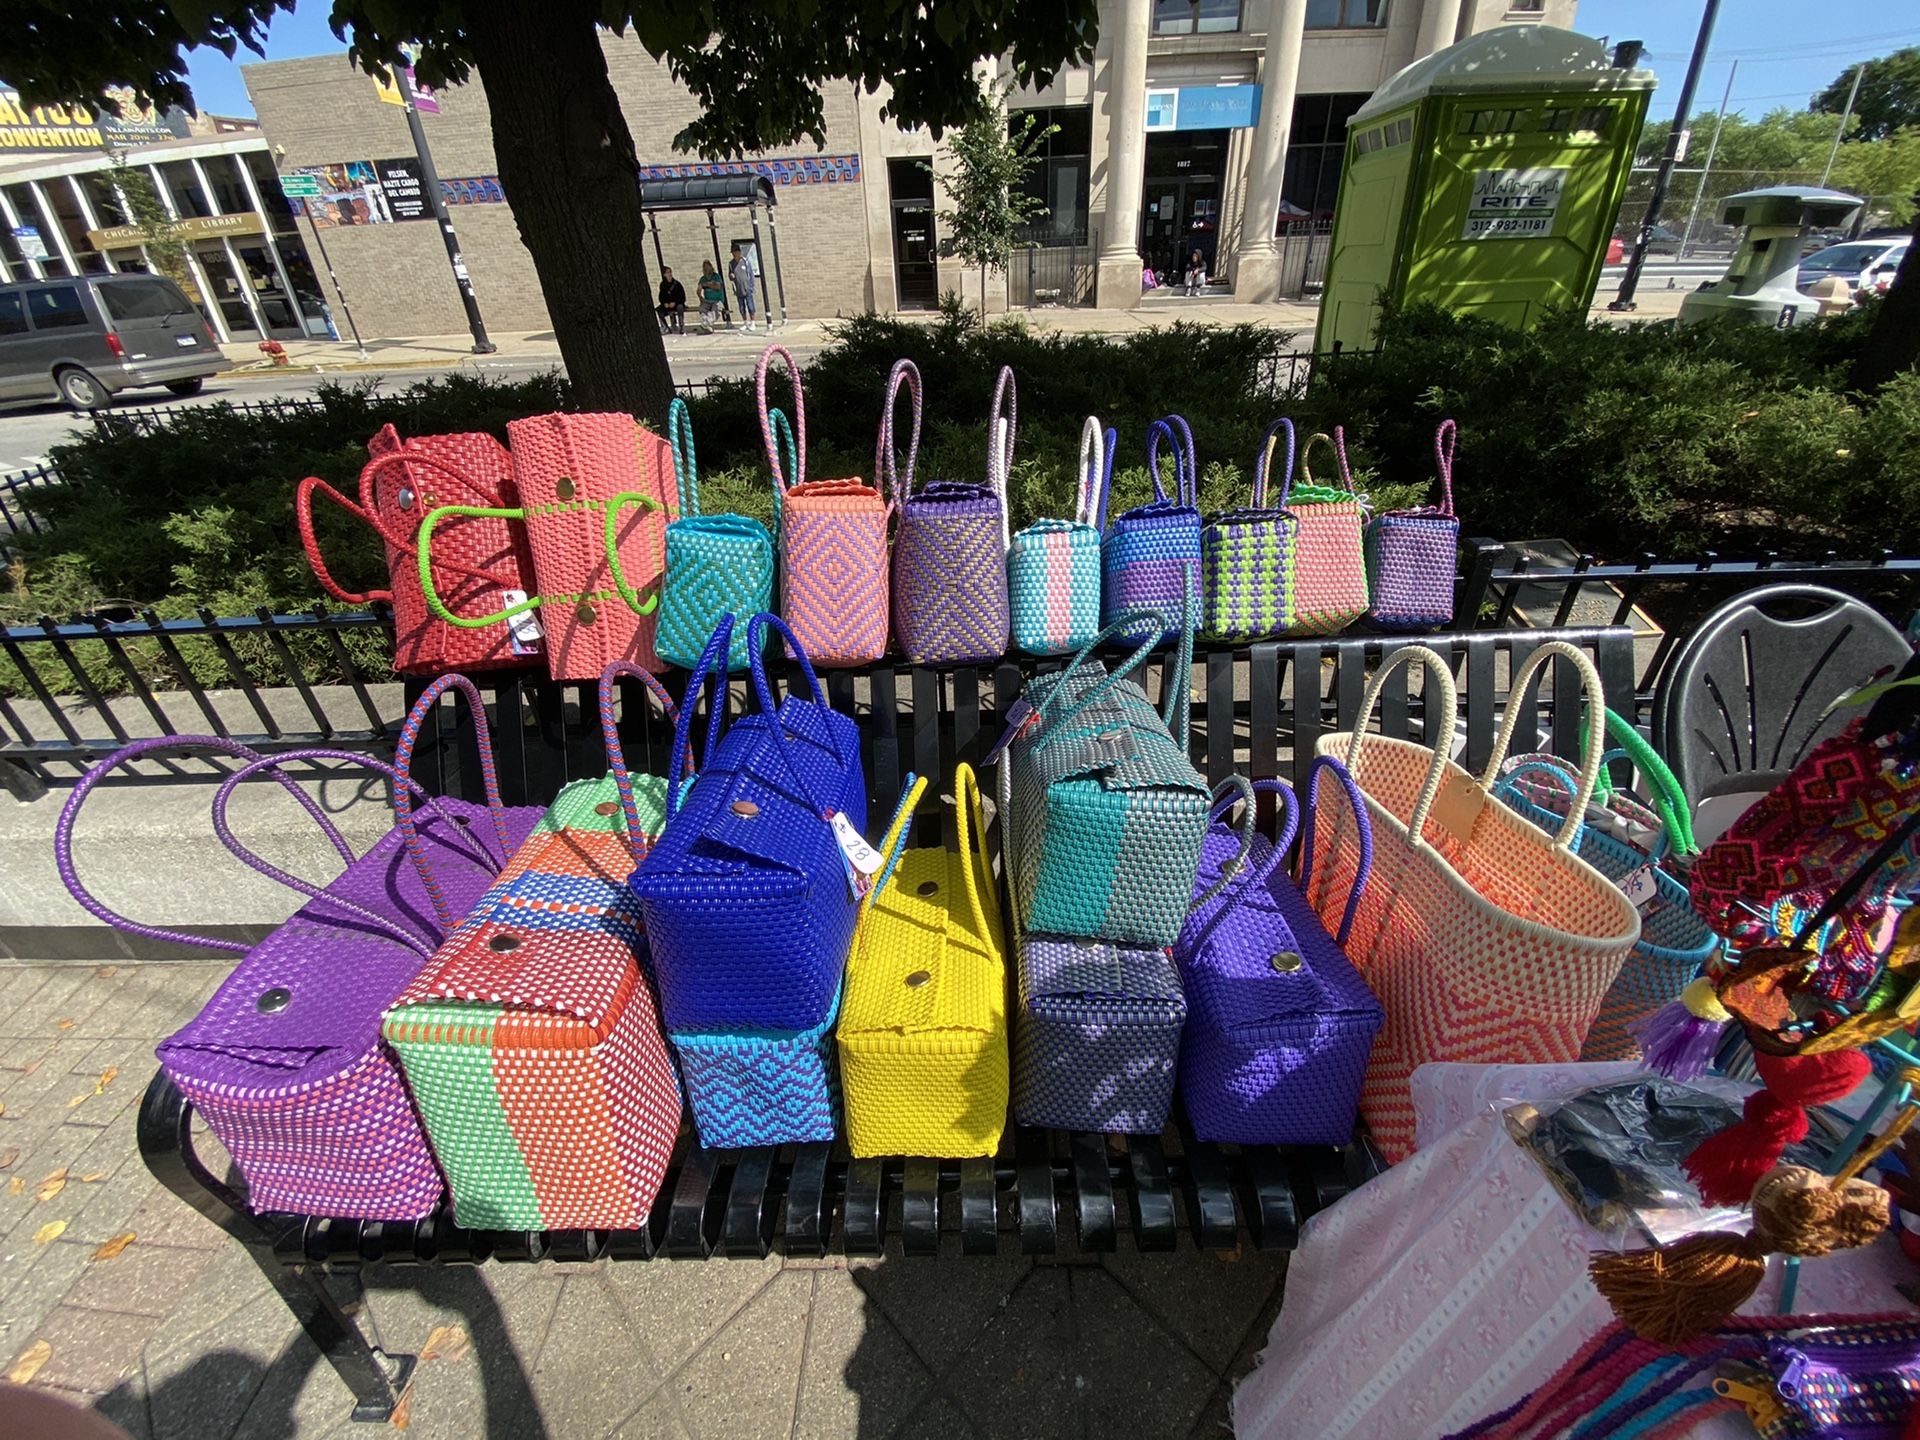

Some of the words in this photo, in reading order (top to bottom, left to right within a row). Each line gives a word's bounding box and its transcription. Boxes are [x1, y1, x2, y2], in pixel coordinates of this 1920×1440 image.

[0, 127, 104, 147] ONVENTION
[1480, 195, 1548, 207] RITE
[104, 228, 147, 240] CHICA
[201, 217, 243, 229] LIBRARY
[1471, 220, 1546, 231] 312-982-1181
